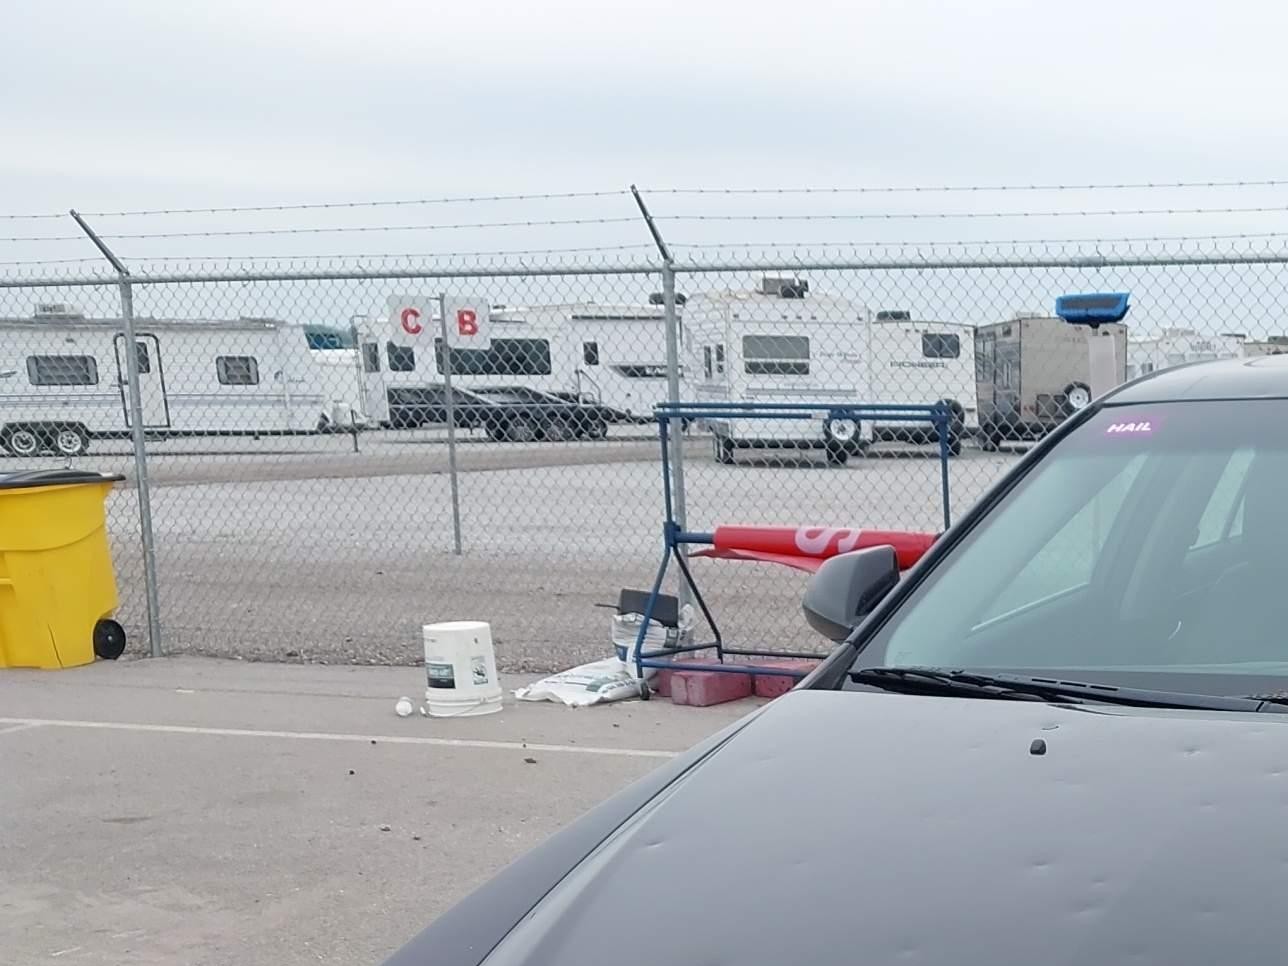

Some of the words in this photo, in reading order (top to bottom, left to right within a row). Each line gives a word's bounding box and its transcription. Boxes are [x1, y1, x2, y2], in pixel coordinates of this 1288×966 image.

[400, 308, 422, 334] C
[457, 309, 479, 336] B
[1107, 421, 1152, 433] HAIL
